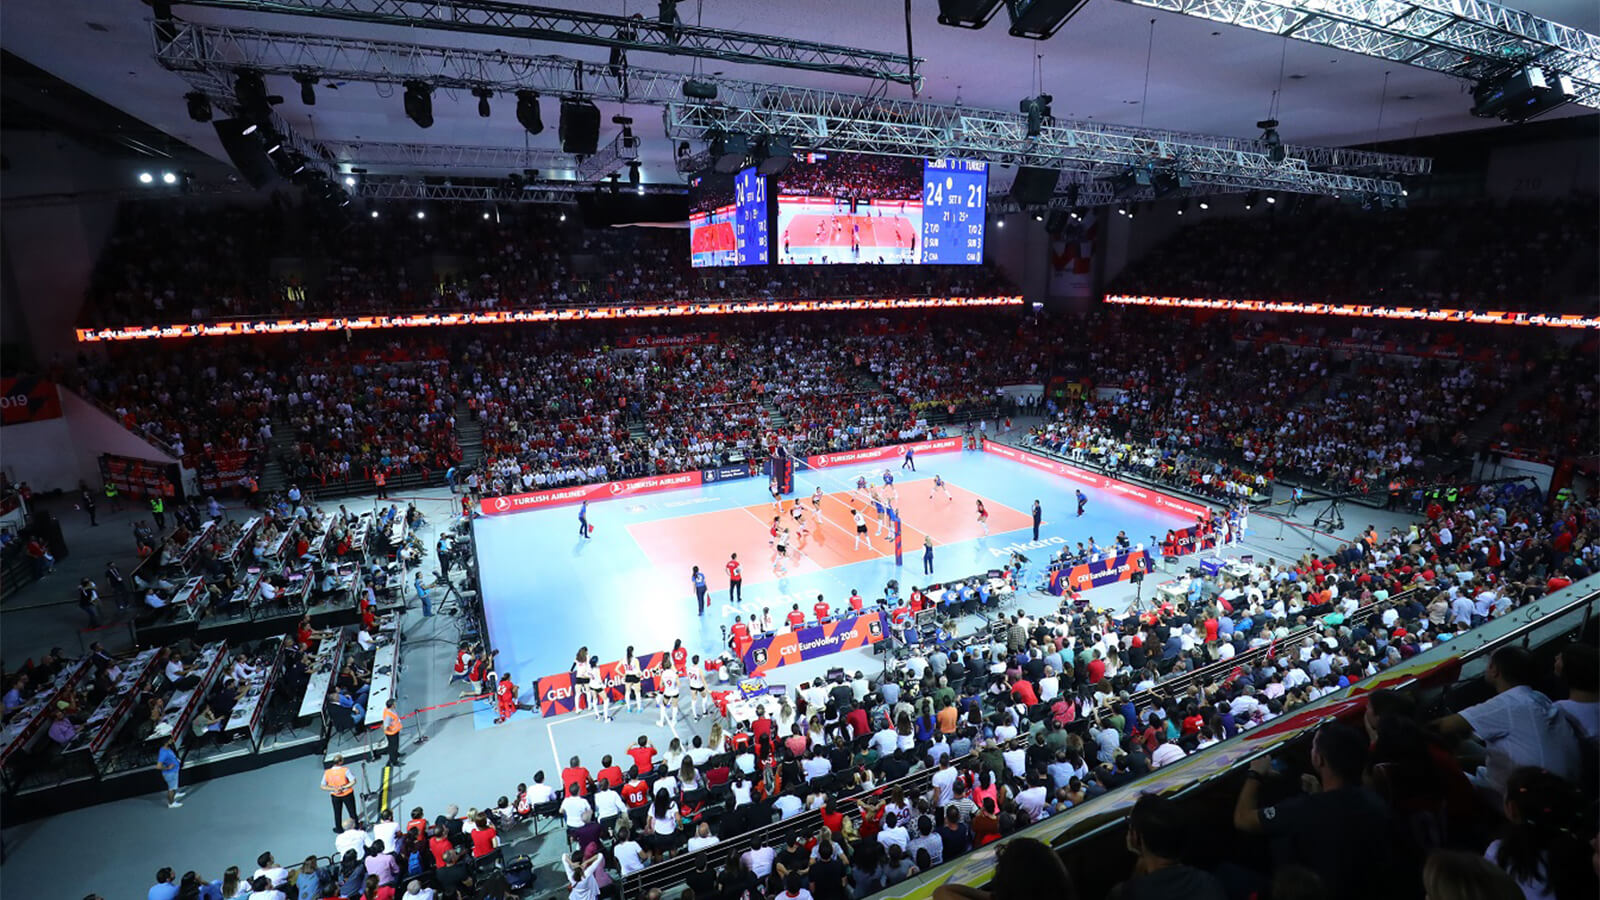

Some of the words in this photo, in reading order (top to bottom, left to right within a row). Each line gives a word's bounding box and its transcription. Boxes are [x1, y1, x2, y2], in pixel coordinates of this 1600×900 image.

[736, 183, 745, 207] 24
[756, 177, 765, 202] 21
[926, 182, 943, 206] 24
[967, 184, 983, 208] 21
[948, 195, 957, 204] SET
[943, 211, 950, 221] 21
[924, 222, 929, 234] 2
[978, 224, 982, 235] 2
[923, 251, 928, 262] 2
[933, 440, 956, 449] AIRLINES
[830, 454, 855, 463] TURKISH
[857, 450, 882, 459] AIRLINES
[626, 480, 658, 490] TURKISH
[660, 476, 692, 486] AIRLINES
[514, 494, 549, 506] TURKISH
[551, 490, 587, 501] AIRLINES
[989, 536, 1068, 557] Ankara
[1077, 573, 1089, 583] CEV
[1090, 569, 1118, 580] EuroVolley
[1118, 563, 1131, 573] 2019
[780, 644, 798, 656] CEV
[799, 635, 840, 651] EuroVolley
[841, 630, 859, 642] 2019
[547, 686, 573, 701] CEV
[630, 791, 643, 803] 06
